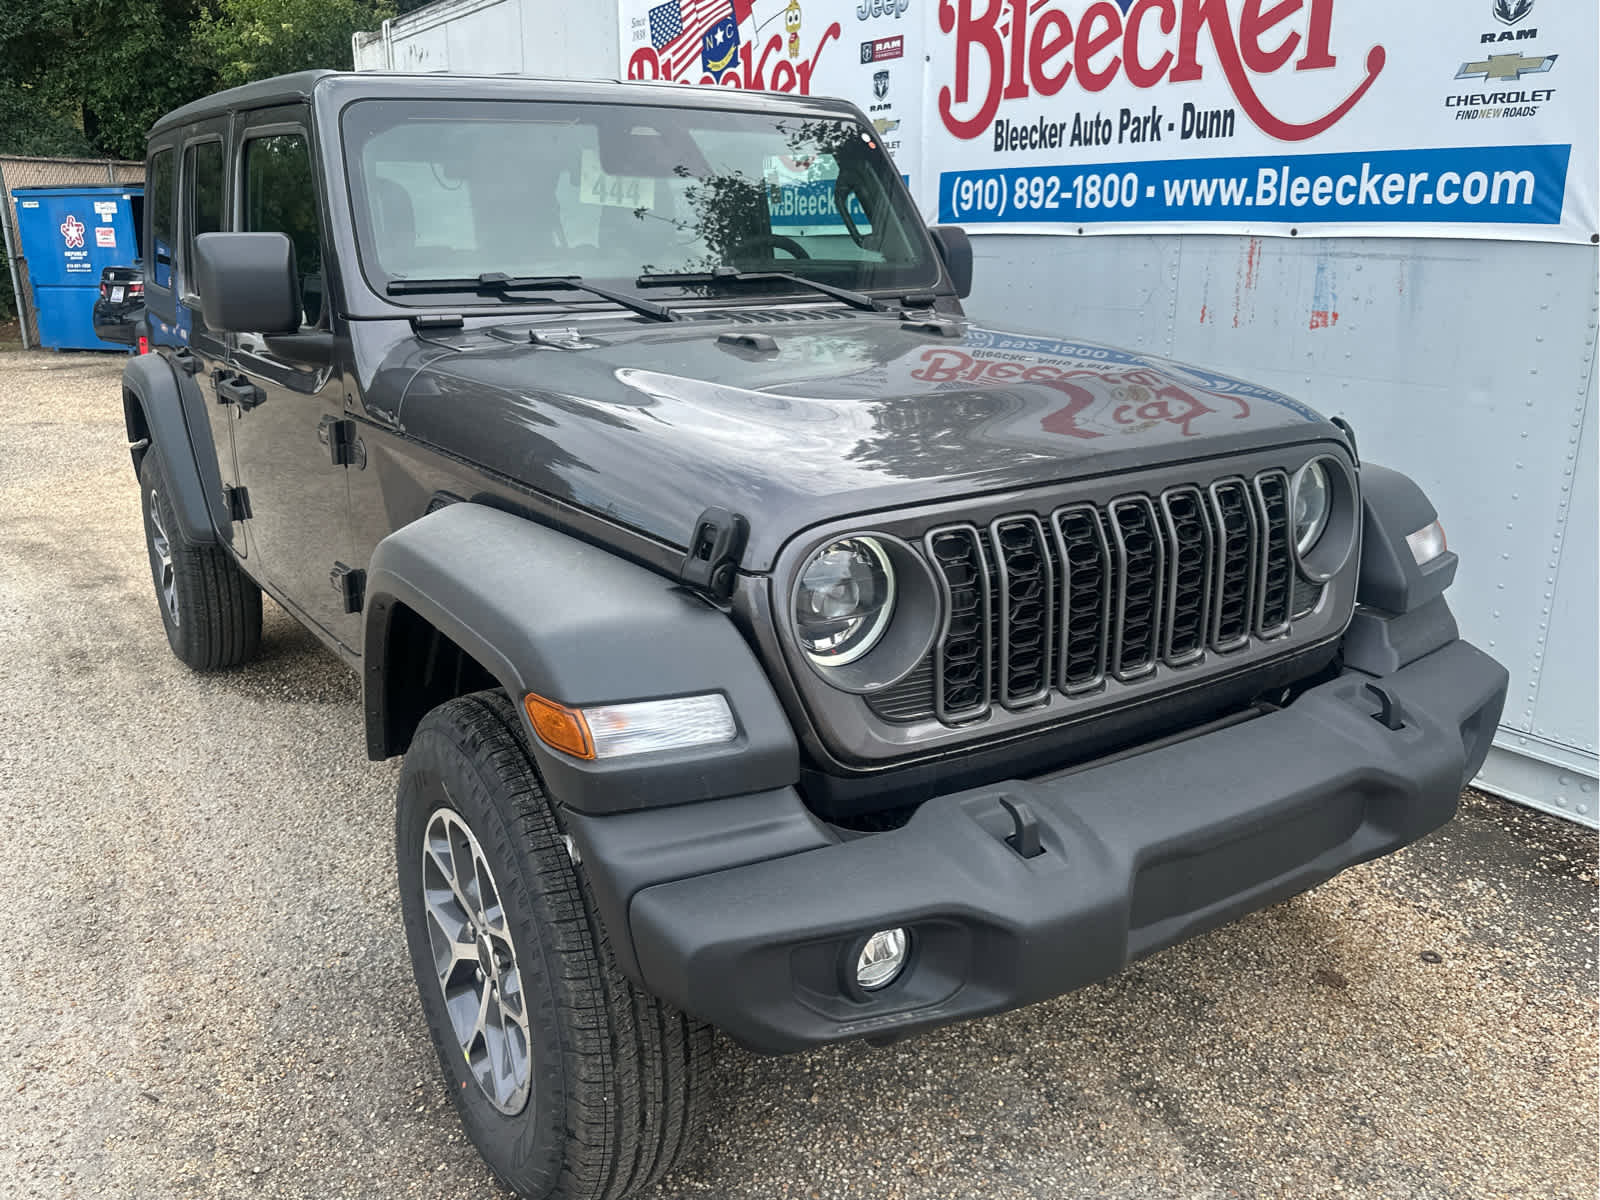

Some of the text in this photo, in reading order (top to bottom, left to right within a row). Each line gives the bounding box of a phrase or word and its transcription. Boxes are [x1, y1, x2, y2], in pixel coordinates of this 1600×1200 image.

[857, 0, 909, 21] Jeep
[1480, 28, 1538, 44] RAM
[875, 40, 901, 51] RAM
[938, 0, 1385, 140] Bleecker
[1445, 89, 1556, 107] CHEVROLET
[870, 103, 892, 112] RAM
[1455, 109, 1479, 120] FIND
[993, 102, 1236, 152] Bleecker Auto Park Dunn
[952, 163, 1535, 217] (910) 892-1800 www.Bleecker.com
